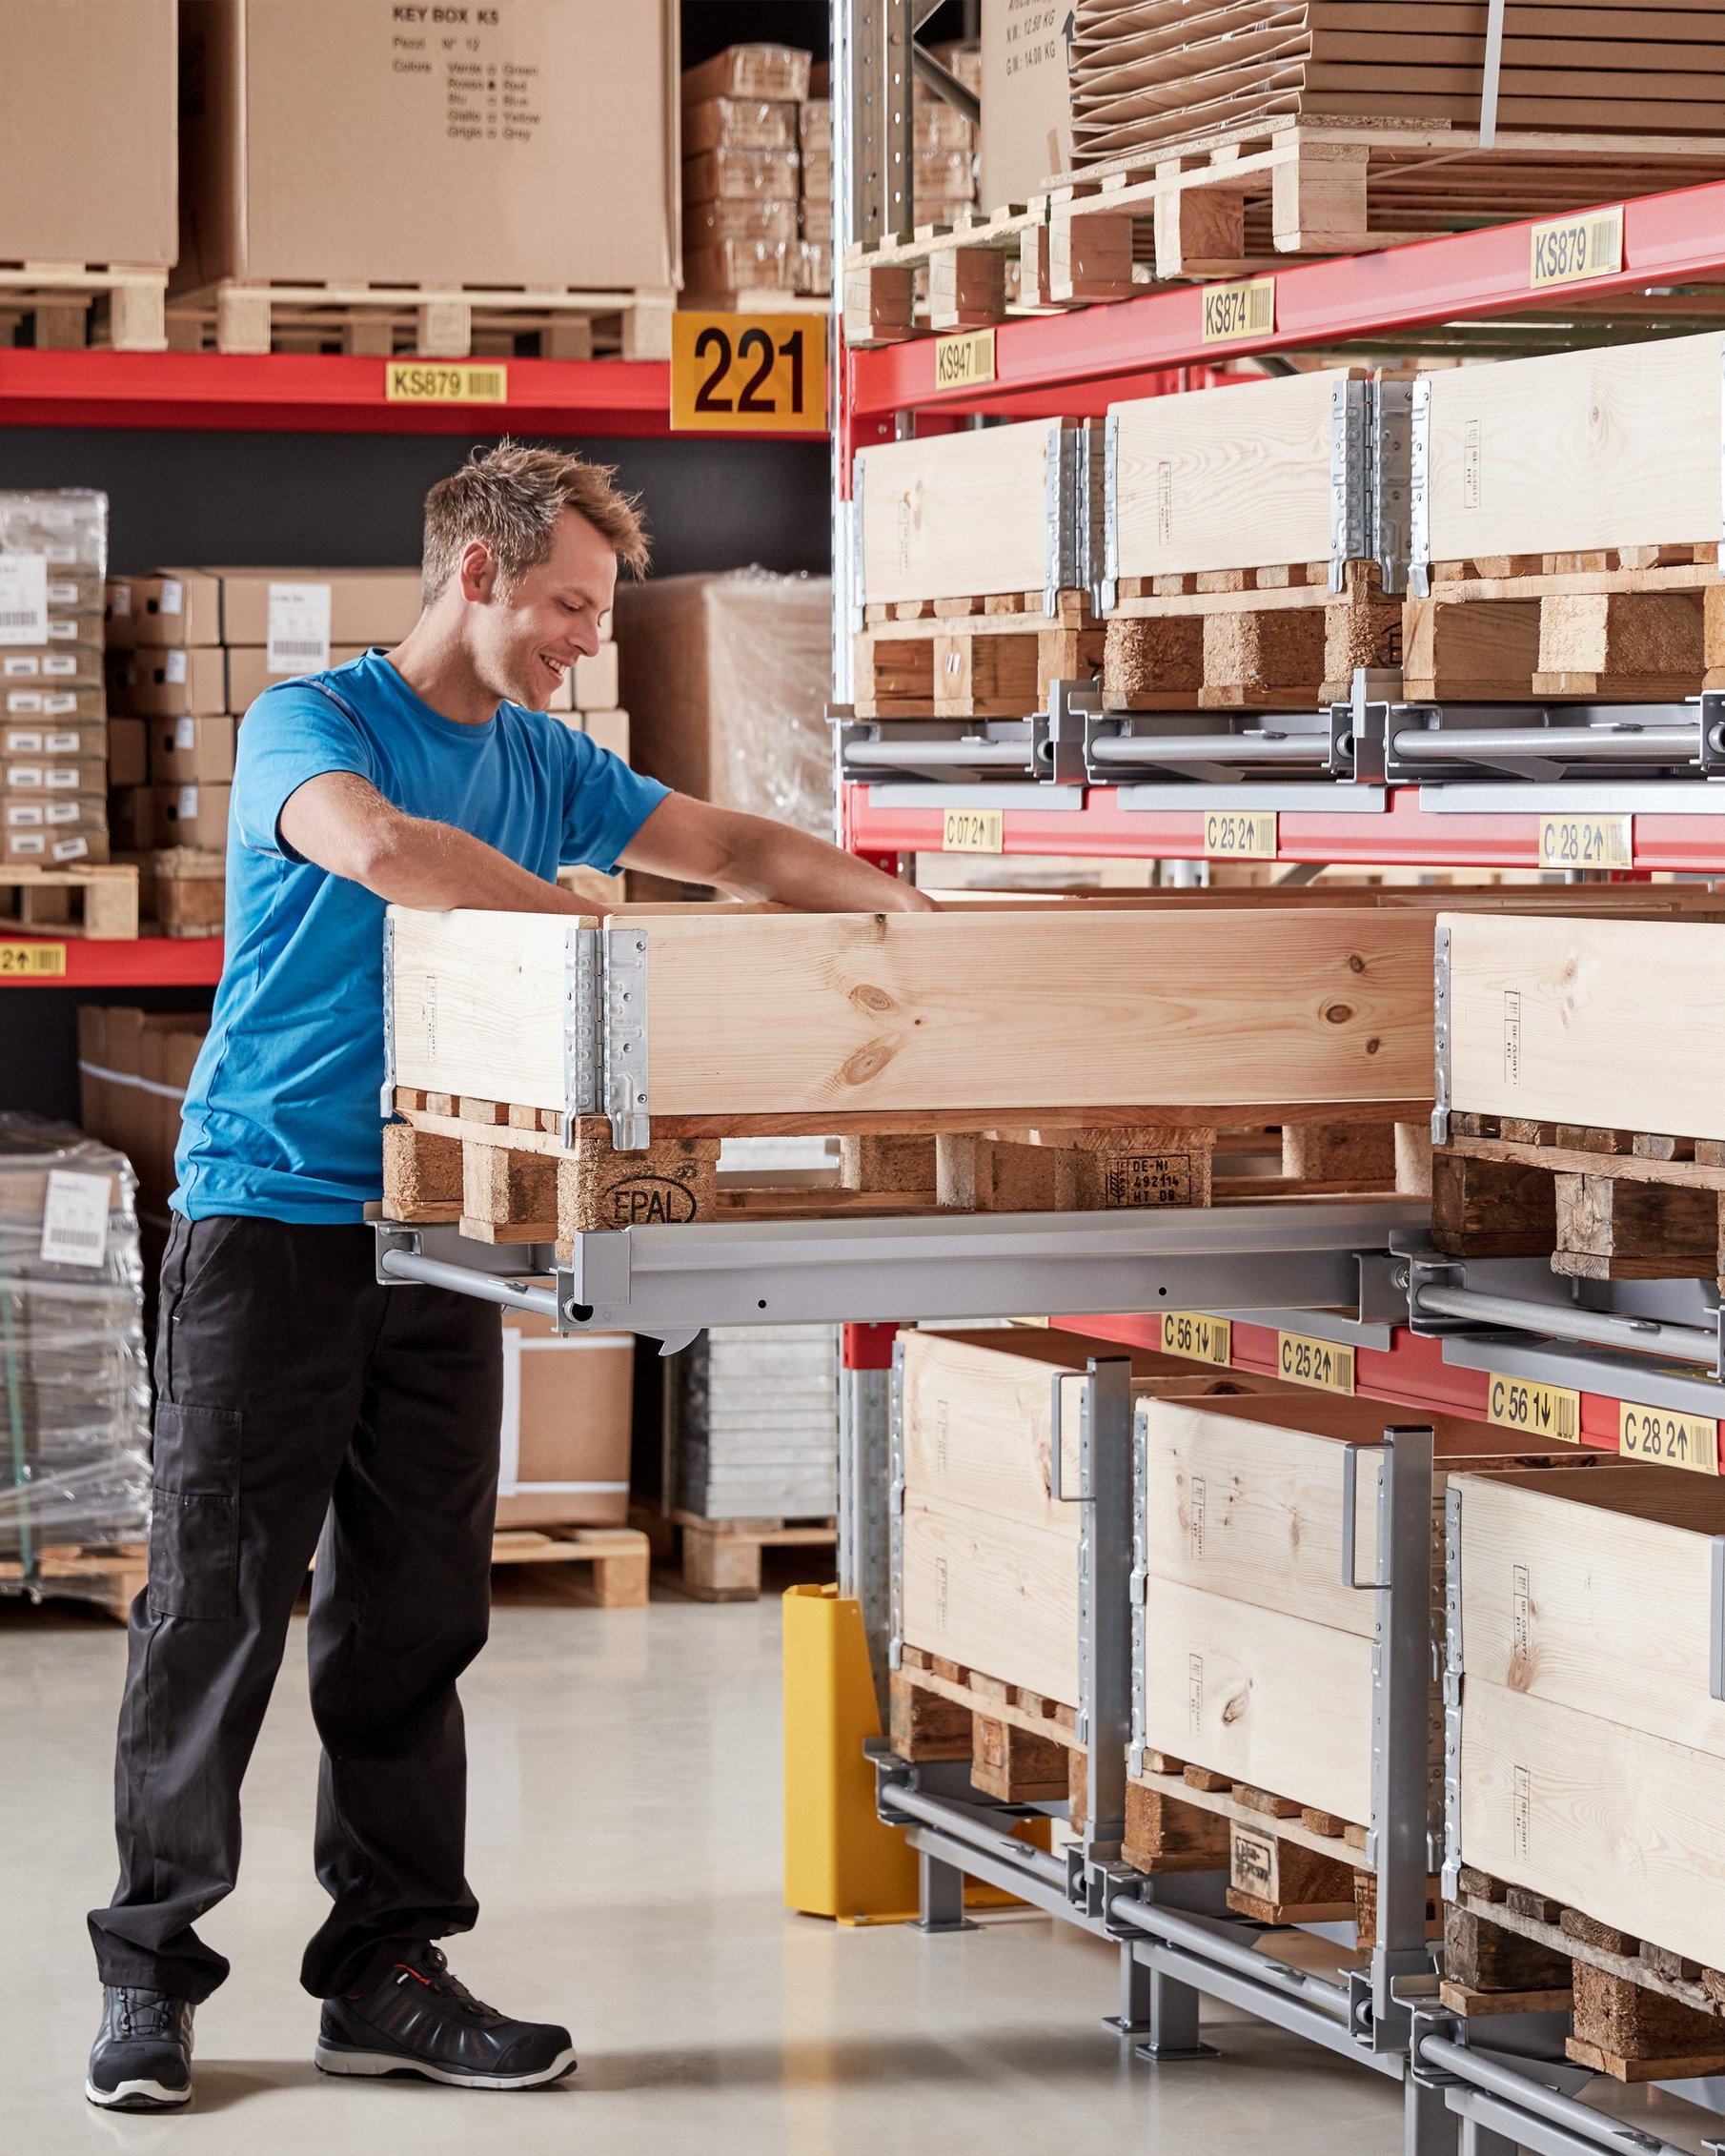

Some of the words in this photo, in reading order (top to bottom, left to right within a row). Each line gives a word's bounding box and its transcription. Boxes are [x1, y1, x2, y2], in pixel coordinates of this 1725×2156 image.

[393, 7, 427, 23] KEY
[433, 8, 468, 24] BOX
[1044, 9, 1055, 28] KG
[1045, 40, 1055, 60] KG
[502, 79, 527, 92] Red
[1535, 226, 1587, 279] KS879
[1206, 291, 1246, 336] KS874
[695, 327, 803, 415] 221
[939, 342, 971, 382] KS947
[394, 370, 461, 396] KS879
[947, 816, 955, 844] C
[957, 816, 969, 845] 07
[972, 817, 978, 844] 2
[1208, 816, 1217, 849] C
[1221, 817, 1235, 849] 25
[1238, 818, 1246, 849] 2
[1544, 824, 1555, 860] C
[1560, 824, 1579, 860] 28
[1583, 824, 1593, 860] 2
[2, 948, 14, 970] 2
[1133, 1159, 1168, 1172] DE-NI
[1133, 1175, 1179, 1188] 492114
[614, 1190, 682, 1224] EPAL
[1133, 1190, 1149, 1203] HT
[1165, 1314, 1174, 1347] C
[1177, 1317, 1191, 1351] 56
[1195, 1322, 1201, 1353] 1
[1282, 1339, 1291, 1373] C
[1295, 1343, 1310, 1377] 25
[1314, 1347, 1322, 1381] 2
[1492, 1381, 1505, 1417] C
[1509, 1386, 1528, 1423] 56
[1532, 1392, 1539, 1427] 1
[1625, 1412, 1637, 1451] C
[1642, 1415, 1661, 1455] 28
[1666, 1420, 1676, 1458] 2
